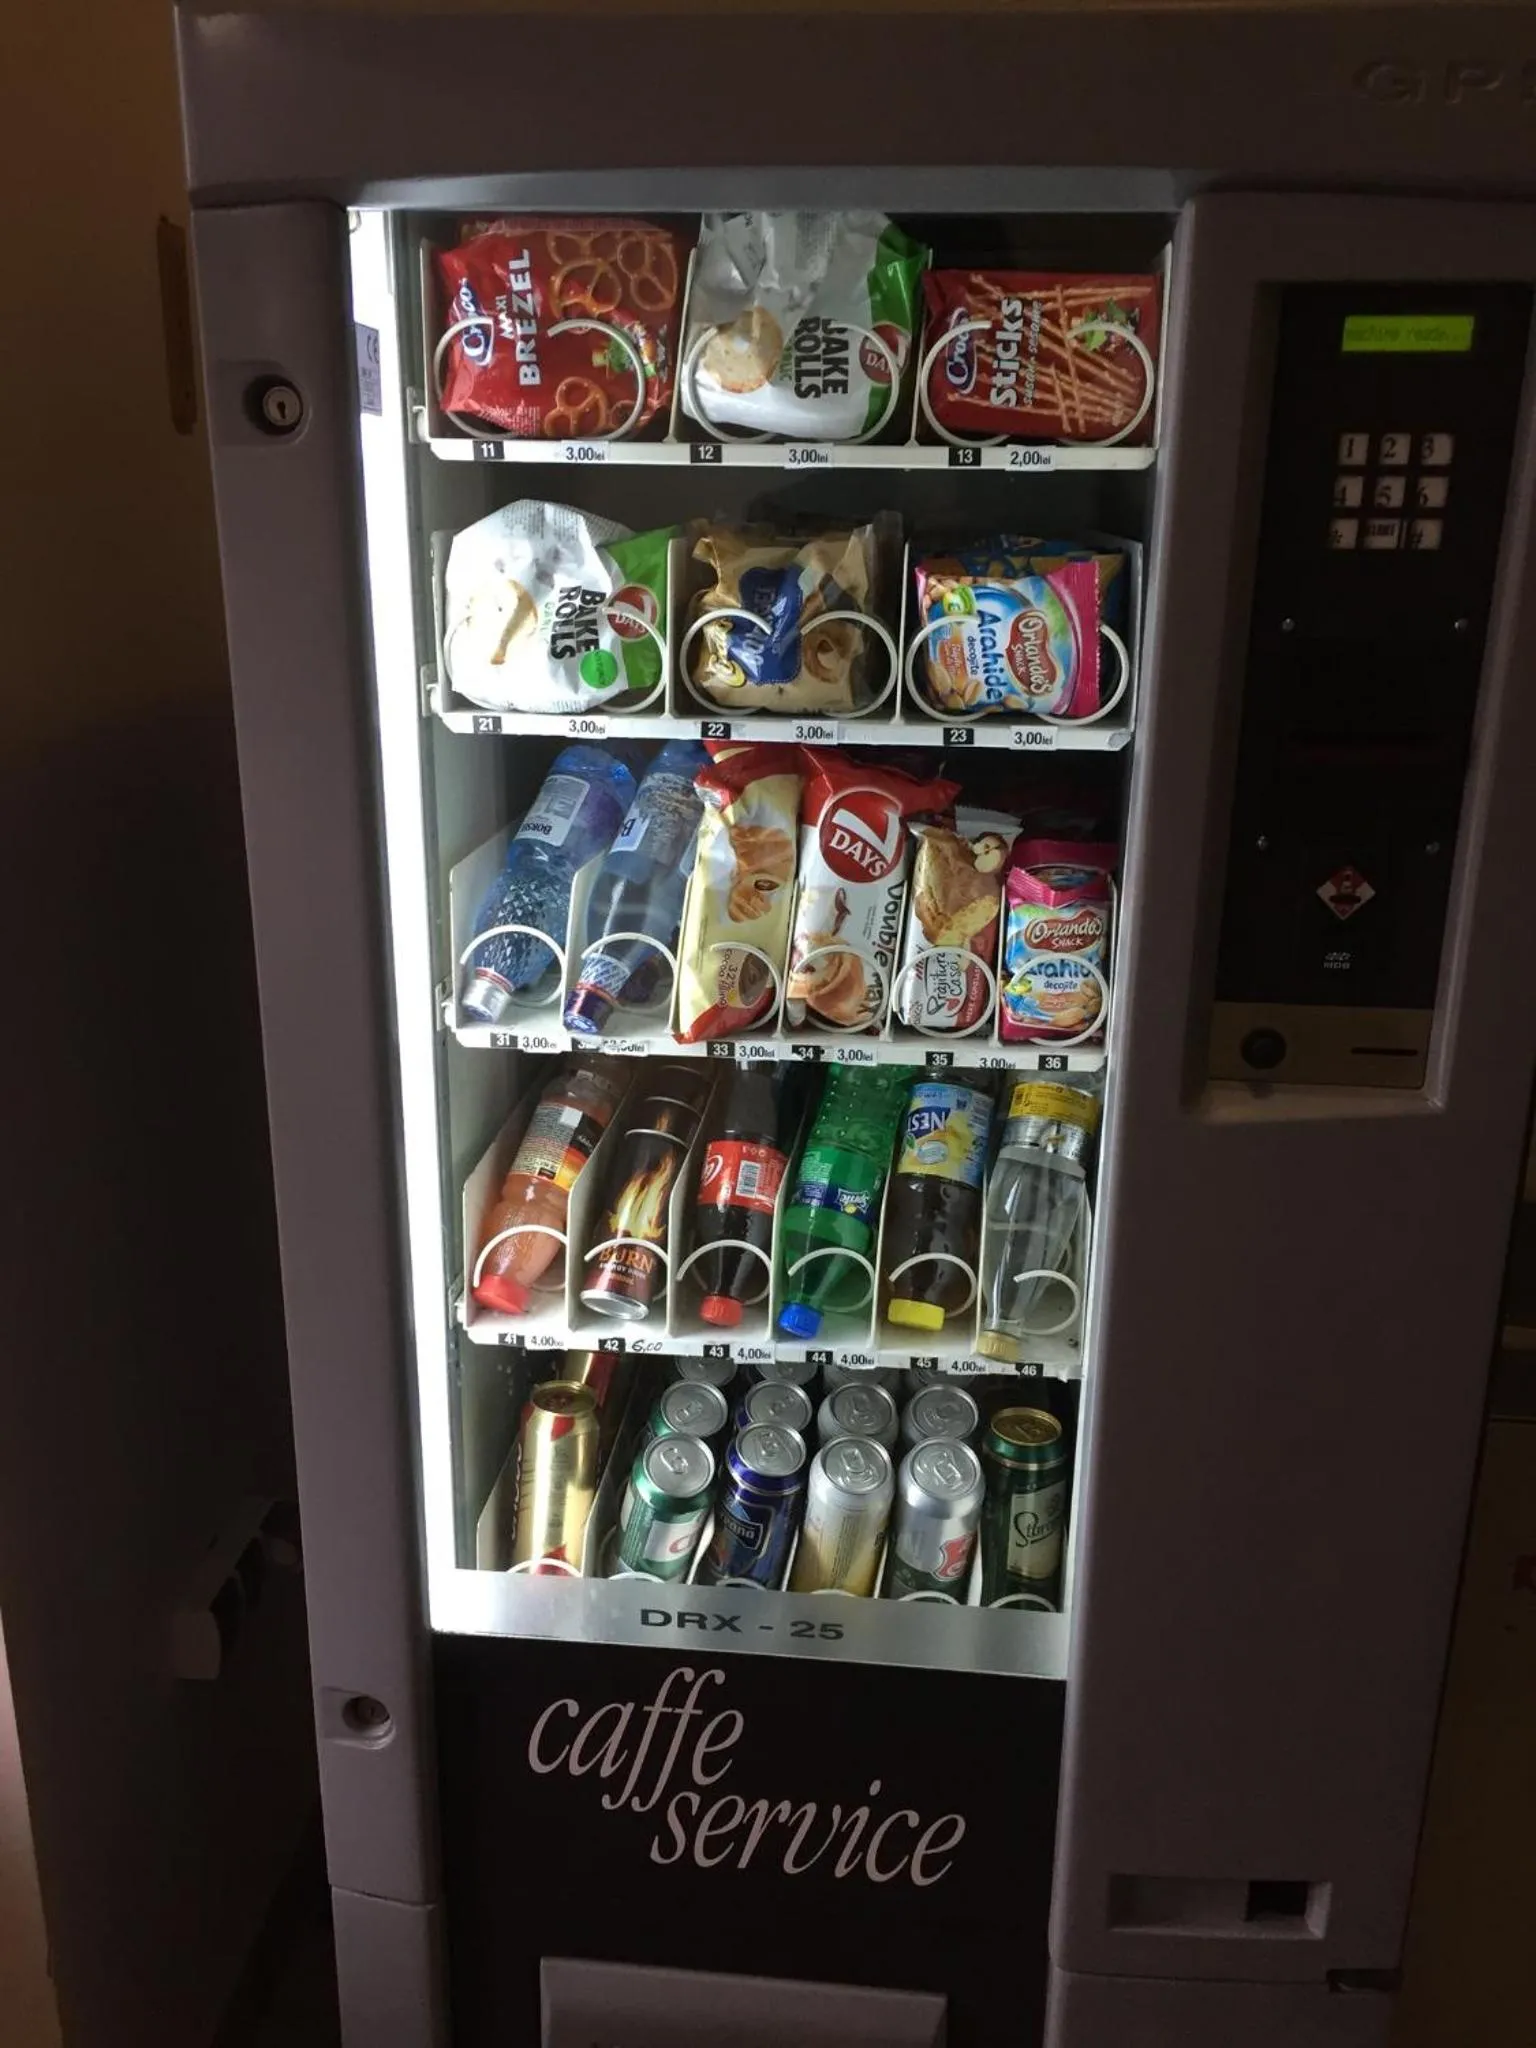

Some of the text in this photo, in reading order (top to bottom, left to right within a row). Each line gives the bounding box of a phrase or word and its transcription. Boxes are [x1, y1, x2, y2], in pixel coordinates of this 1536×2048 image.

[495, 295, 516, 340] MAXI
[508, 248, 541, 386] BREZEL
[793, 316, 822, 400] ROLLS
[990, 296, 1024, 408] Sticks
[480, 442, 496, 458] 11
[698, 446, 715, 461] 12
[956, 449, 974, 464] 13
[551, 585, 582, 660] ROLLS
[574, 589, 607, 653] BAKE
[977, 609, 1008, 701] Arahide
[479, 717, 495, 732] 21
[707, 723, 725, 737] 22
[950, 729, 968, 743] 23
[832, 807, 901, 864] 7
[829, 828, 889, 878] DAYS
[1026, 958, 1100, 979] rahid
[496, 1034, 511, 1046] 31
[713, 1043, 729, 1056] 33
[798, 1047, 815, 1059] 34
[931, 1053, 948, 1066] 35
[1045, 1057, 1062, 1069] 36
[604, 1340, 619, 1352] 42
[709, 1346, 725, 1357] 43
[811, 1352, 827, 1362] 44
[916, 1357, 932, 1369] 45
[1021, 1364, 1037, 1376] 46
[640, 1608, 742, 1633] DRX
[789, 1620, 845, 1641] 25
[527, 1666, 744, 1812] caffe
[649, 1778, 966, 1887] service
